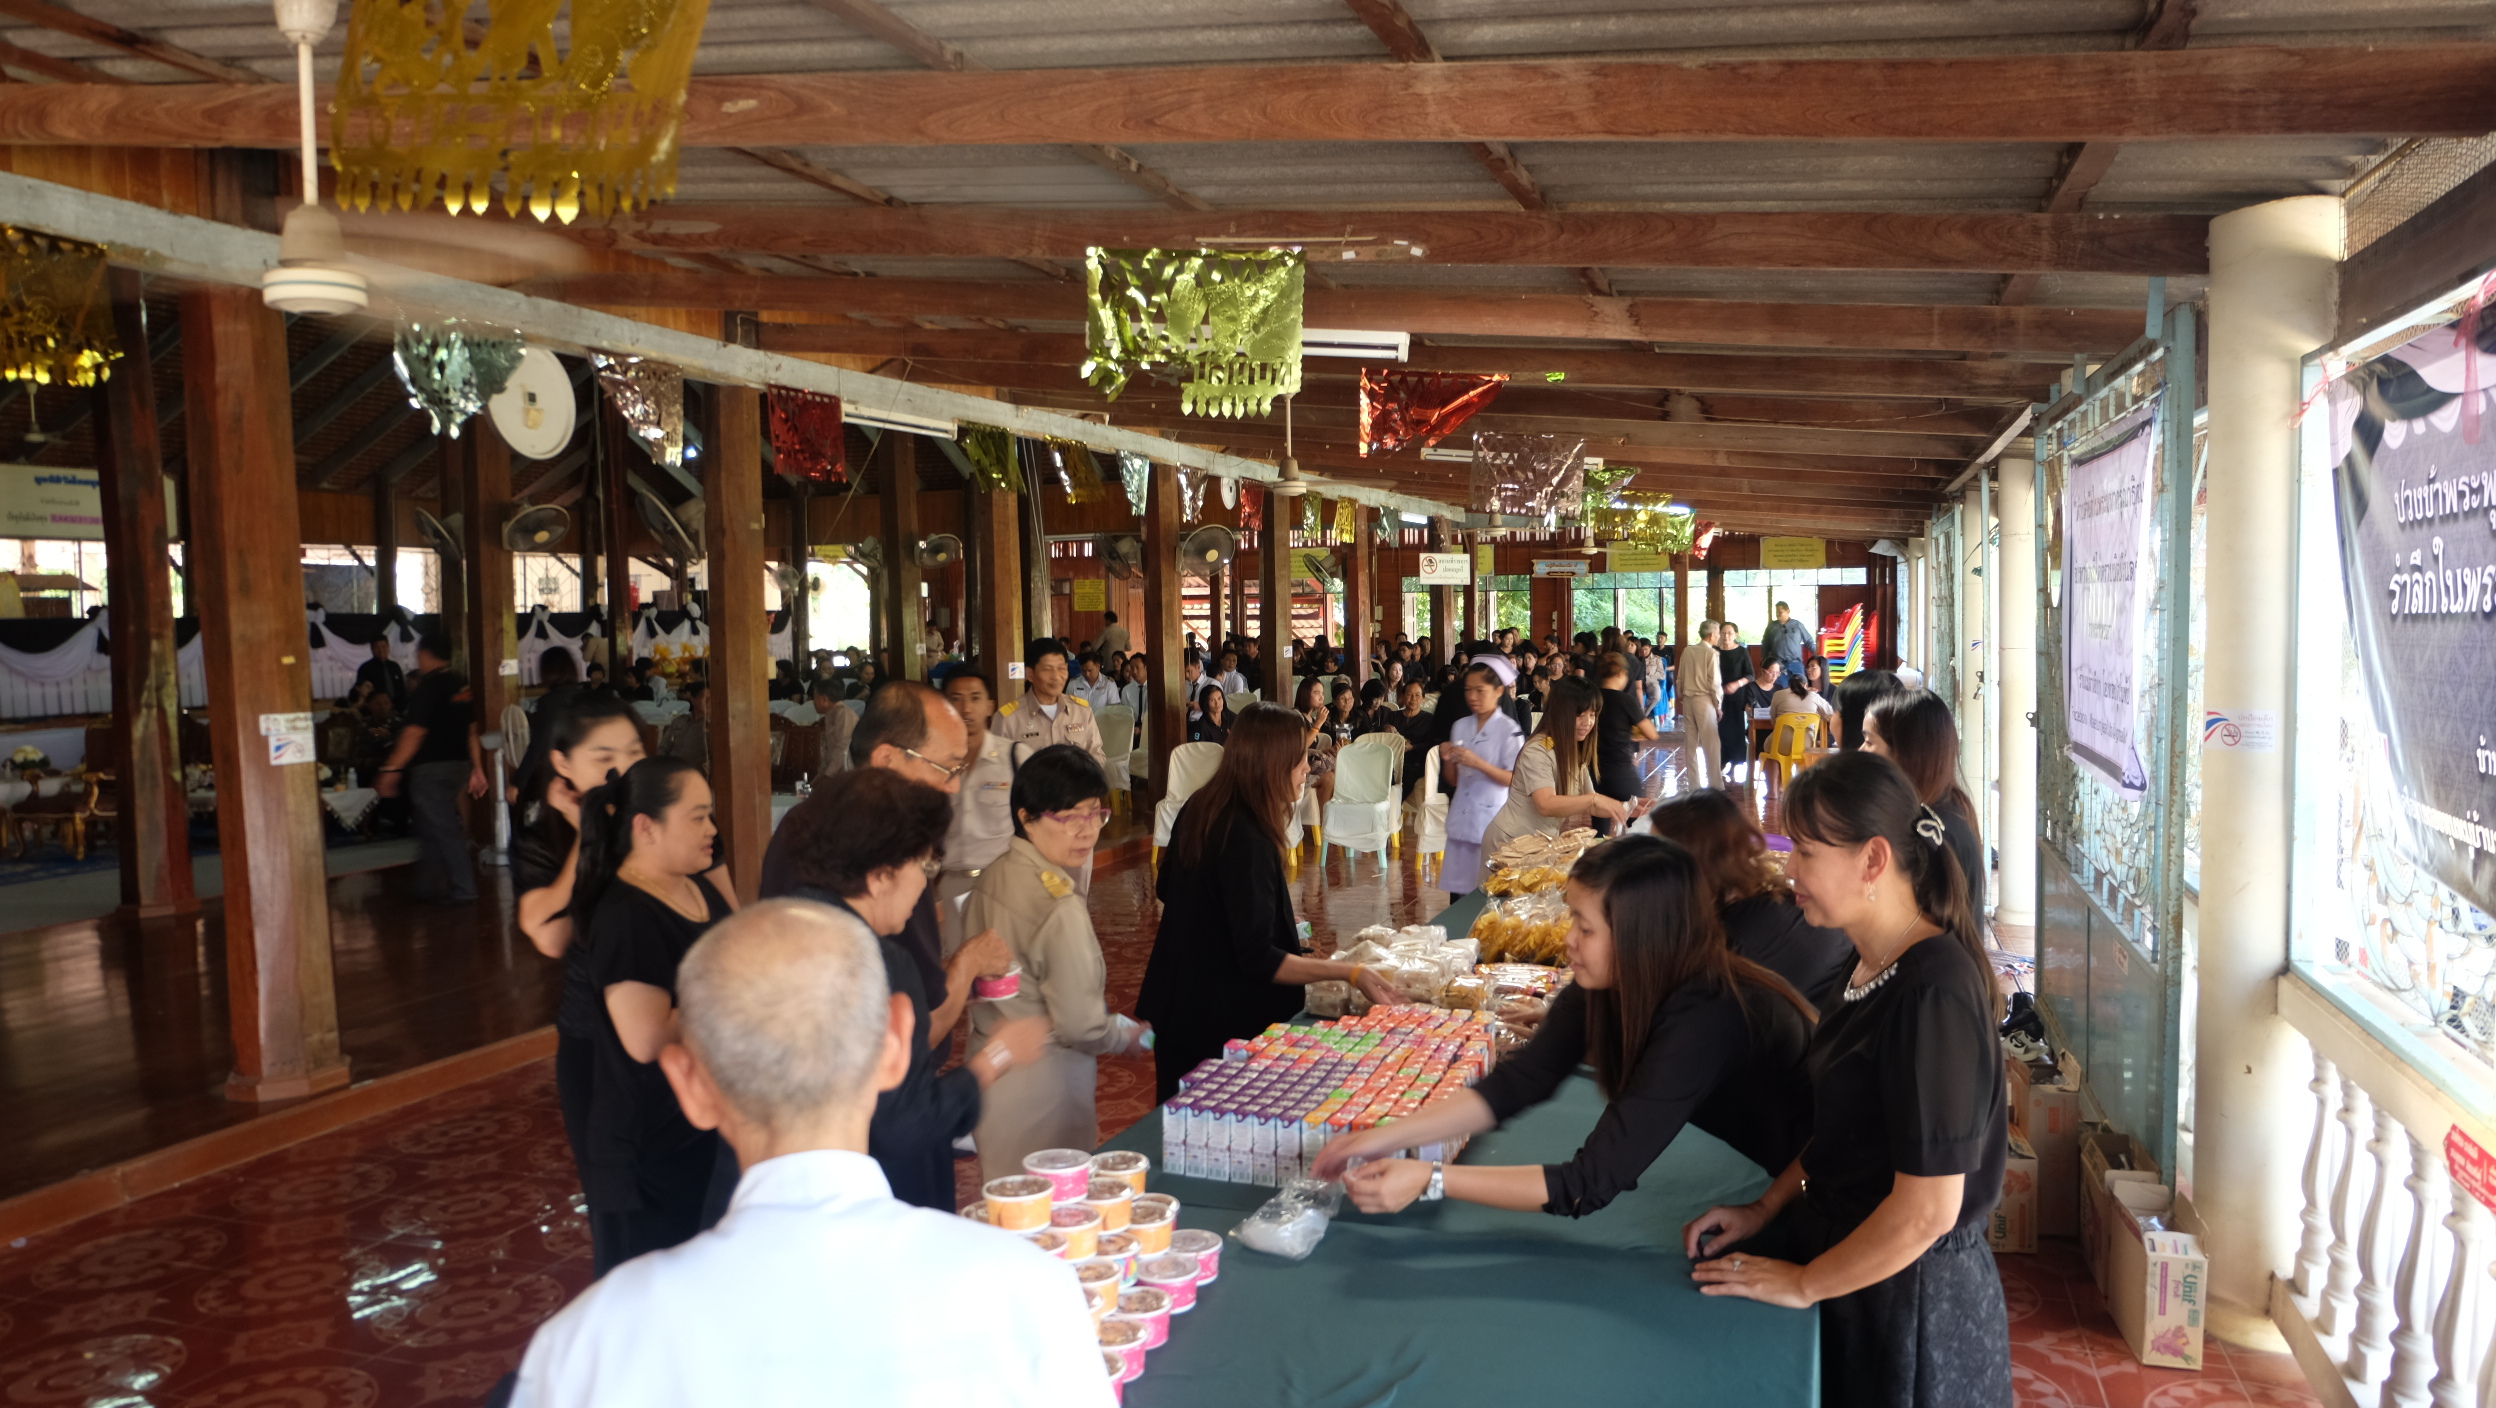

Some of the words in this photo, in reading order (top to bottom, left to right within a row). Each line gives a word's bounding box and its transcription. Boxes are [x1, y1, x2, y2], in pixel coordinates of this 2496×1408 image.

[2389, 536, 2496, 615] รำลึกในพร
[2182, 1274, 2198, 1307] Unif
